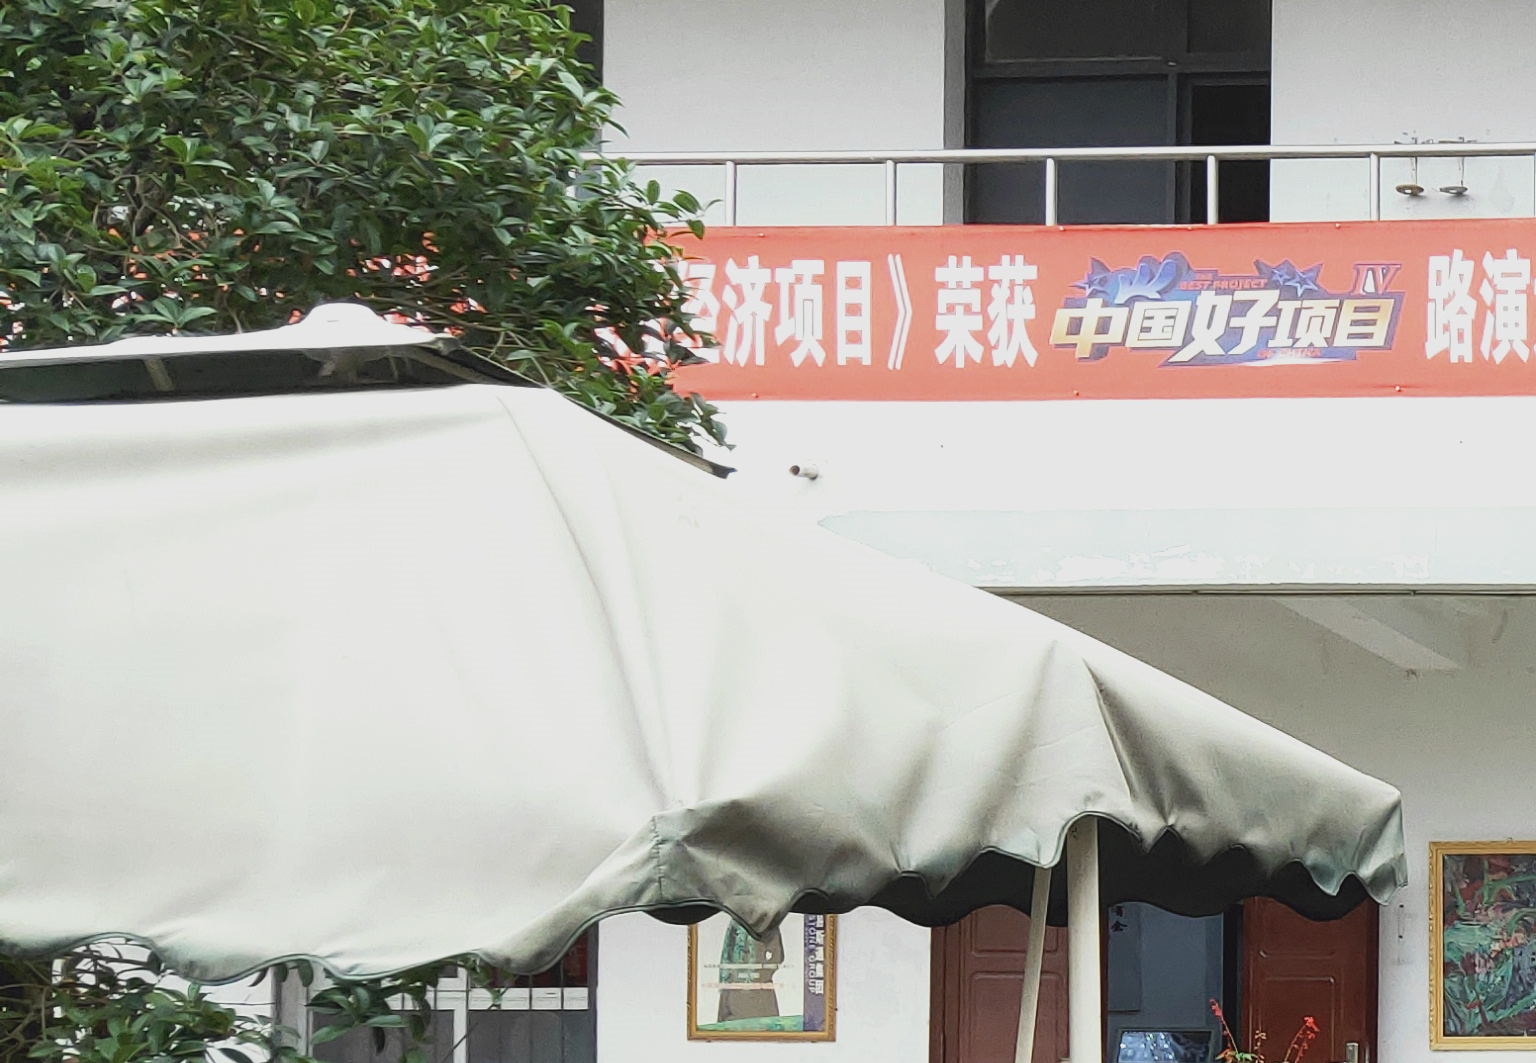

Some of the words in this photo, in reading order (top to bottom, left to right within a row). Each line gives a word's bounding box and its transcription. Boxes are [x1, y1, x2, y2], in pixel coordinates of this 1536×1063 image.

[1050, 289, 1397, 363] 中国好项目
